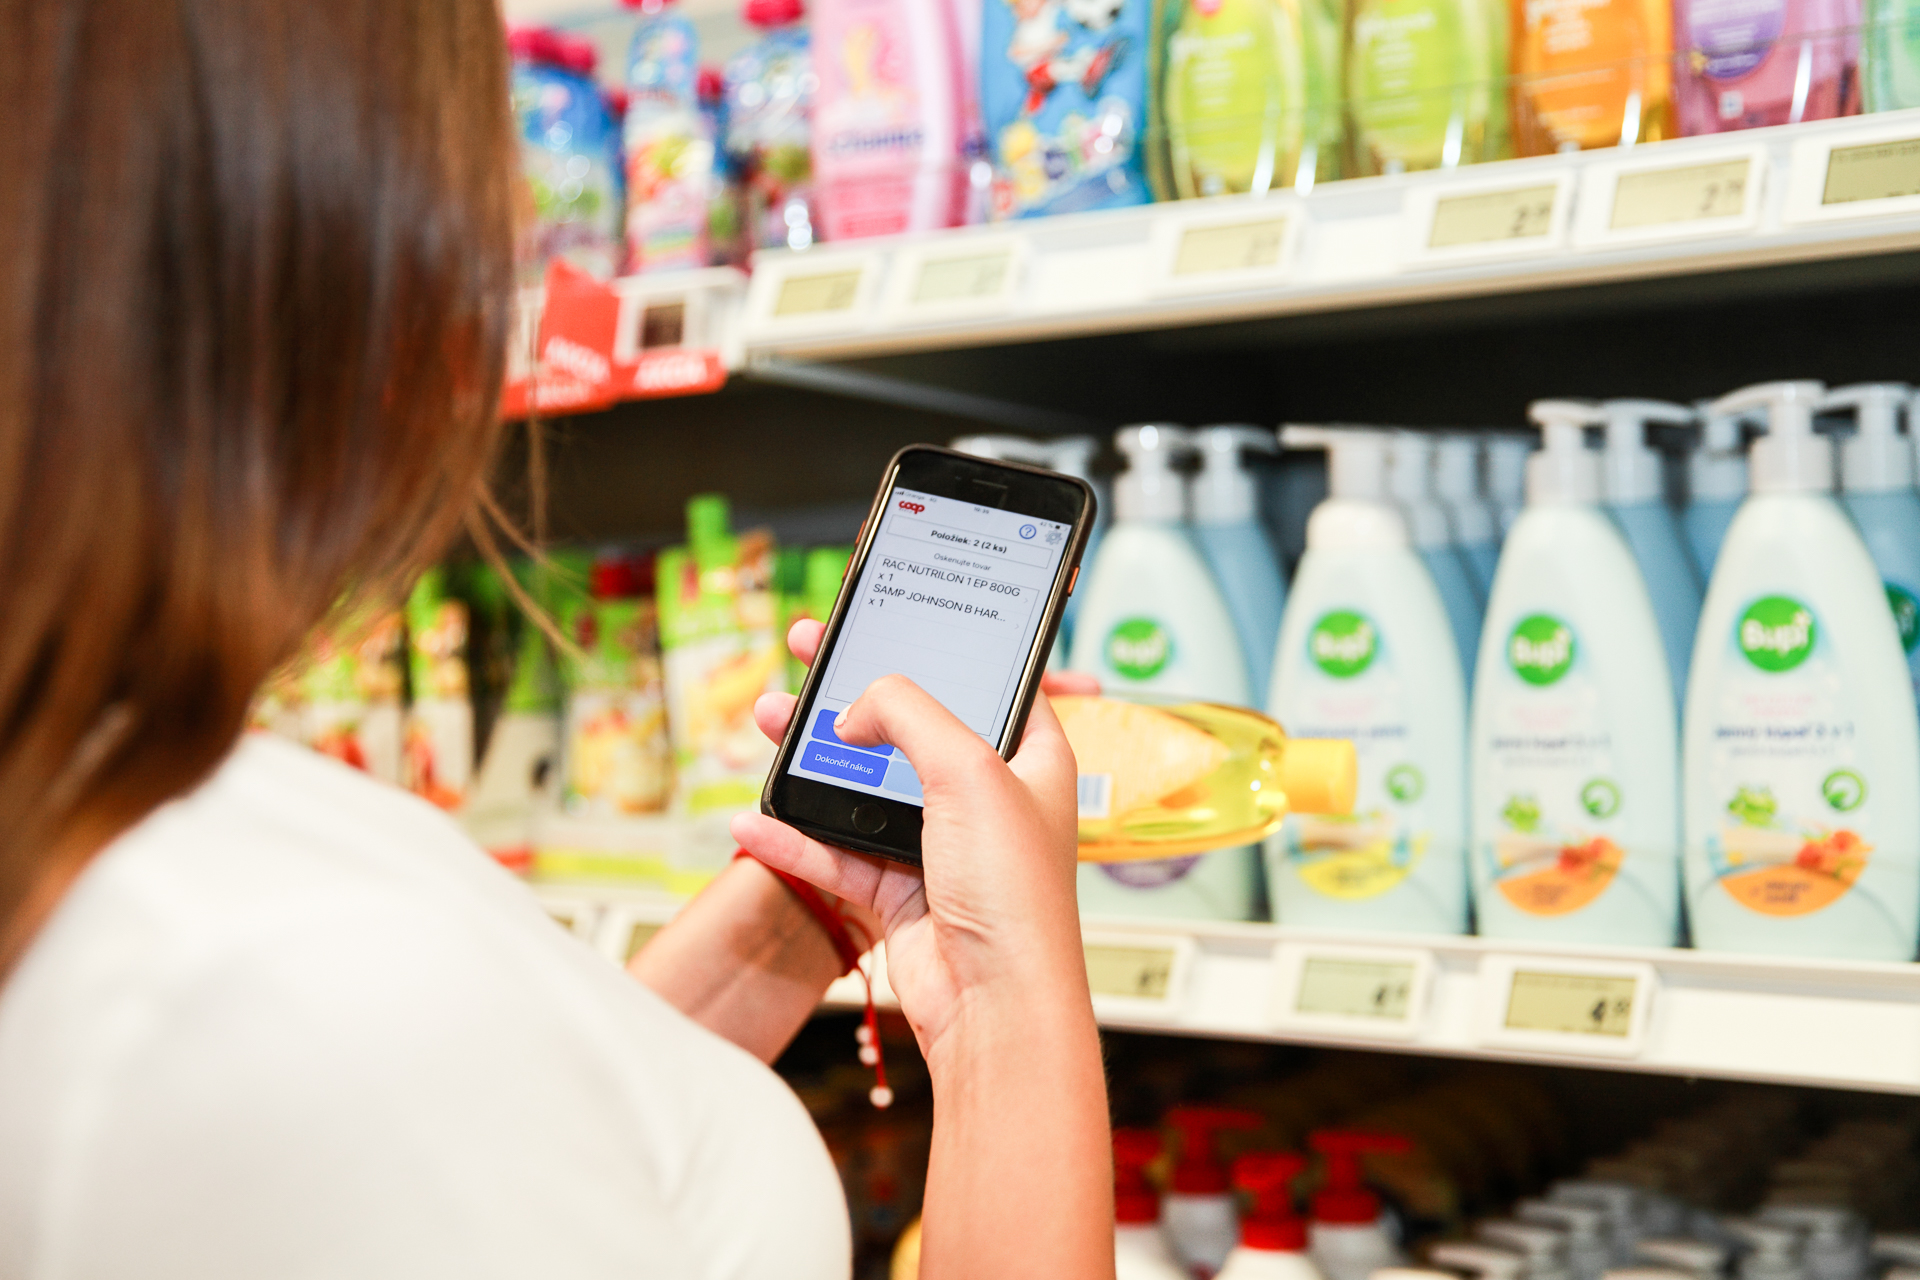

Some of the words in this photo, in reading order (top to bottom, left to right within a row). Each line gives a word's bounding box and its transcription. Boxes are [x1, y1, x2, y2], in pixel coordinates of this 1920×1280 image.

[898, 500, 925, 515] coop
[930, 529, 971, 545] Položiek:
[973, 539, 980, 547] 2
[981, 540, 992, 550] (2
[992, 542, 1007, 554] ks)
[933, 552, 971, 567] Oskenujte
[972, 561, 992, 571] tovar
[877, 572, 884, 580] x
[888, 573, 894, 582] 1
[882, 558, 905, 571] RAC
[907, 563, 965, 584] NUTRILON
[967, 576, 972, 585] 1
[973, 578, 988, 588] EP
[989, 582, 1021, 597] 800G
[872, 583, 906, 597] SAMP
[906, 591, 964, 612] JOHNSON
[964, 604, 973, 614] B
[879, 598, 885, 607] 1
[1740, 610, 1811, 657] Bupi
[815, 755, 850, 768] Dokončiť
[850, 763, 873, 775] nákup
